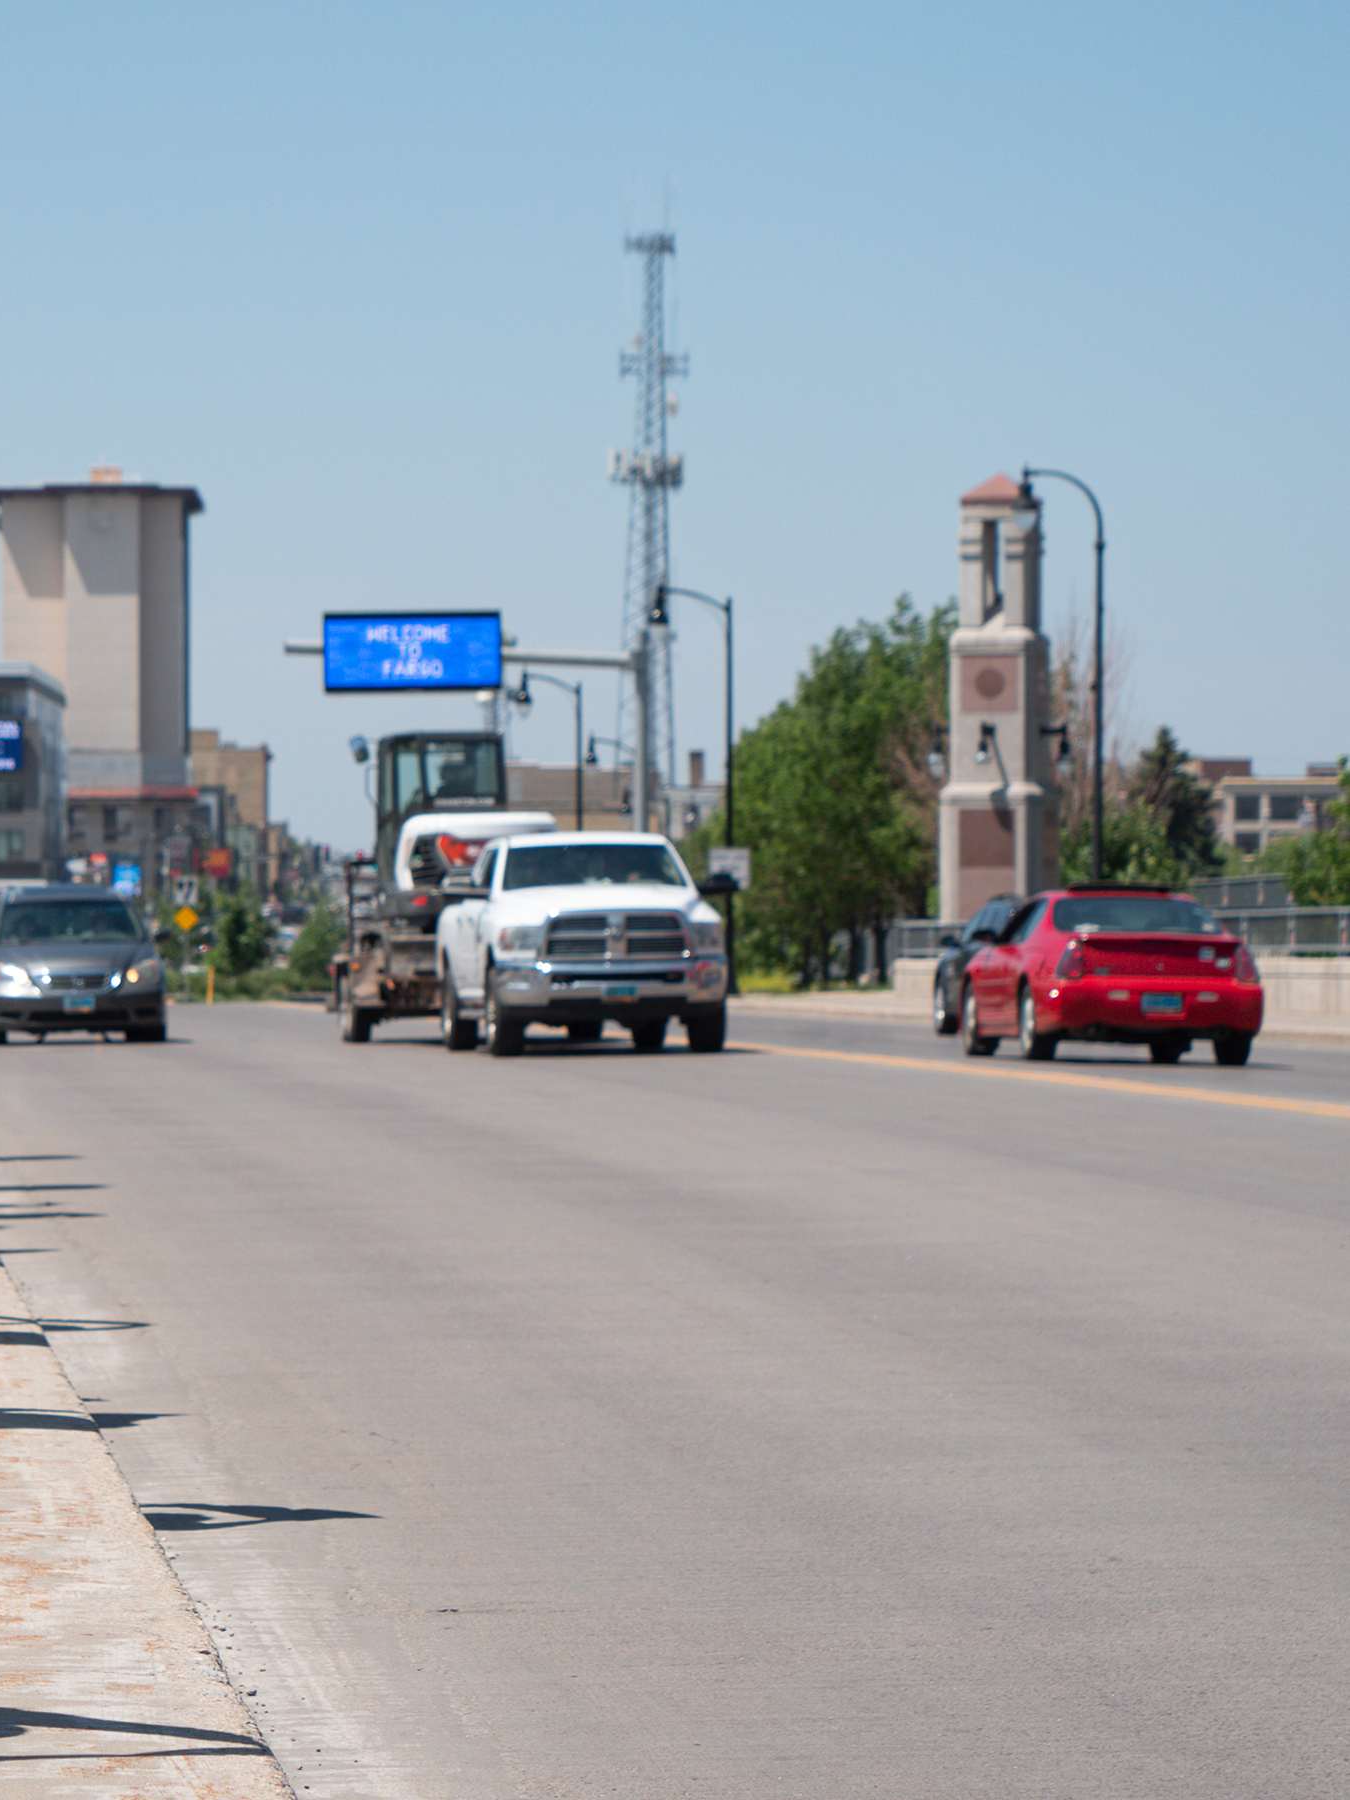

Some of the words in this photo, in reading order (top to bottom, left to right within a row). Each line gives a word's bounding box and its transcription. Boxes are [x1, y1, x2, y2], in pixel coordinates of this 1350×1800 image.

[366, 623, 450, 643] WELCOME
[399, 641, 423, 660] TO
[382, 659, 444, 679] FARGO
